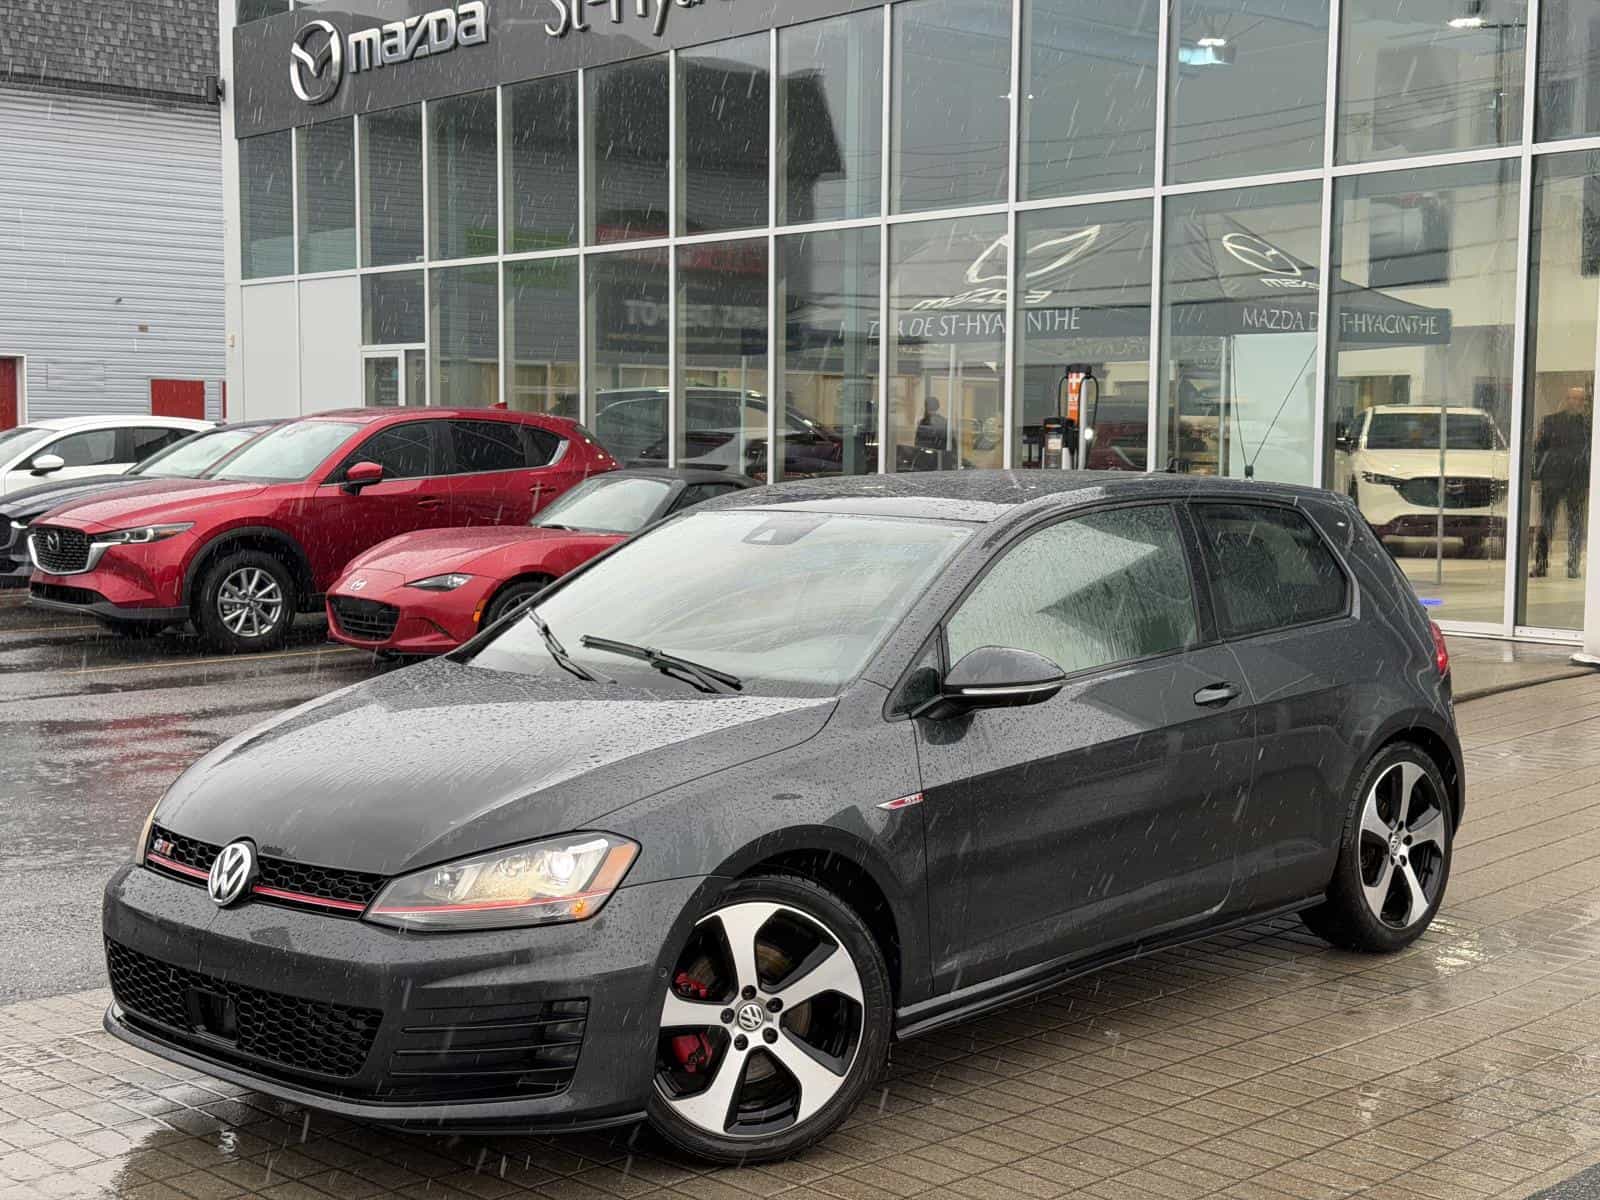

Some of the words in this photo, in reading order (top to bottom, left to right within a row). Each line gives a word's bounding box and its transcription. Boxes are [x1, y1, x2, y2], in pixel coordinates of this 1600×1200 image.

[936, 307, 1081, 337] ST-HYANTHE
[1242, 307, 1304, 330] MAZDA
[1338, 312, 1441, 336] T-HYACINTHE
